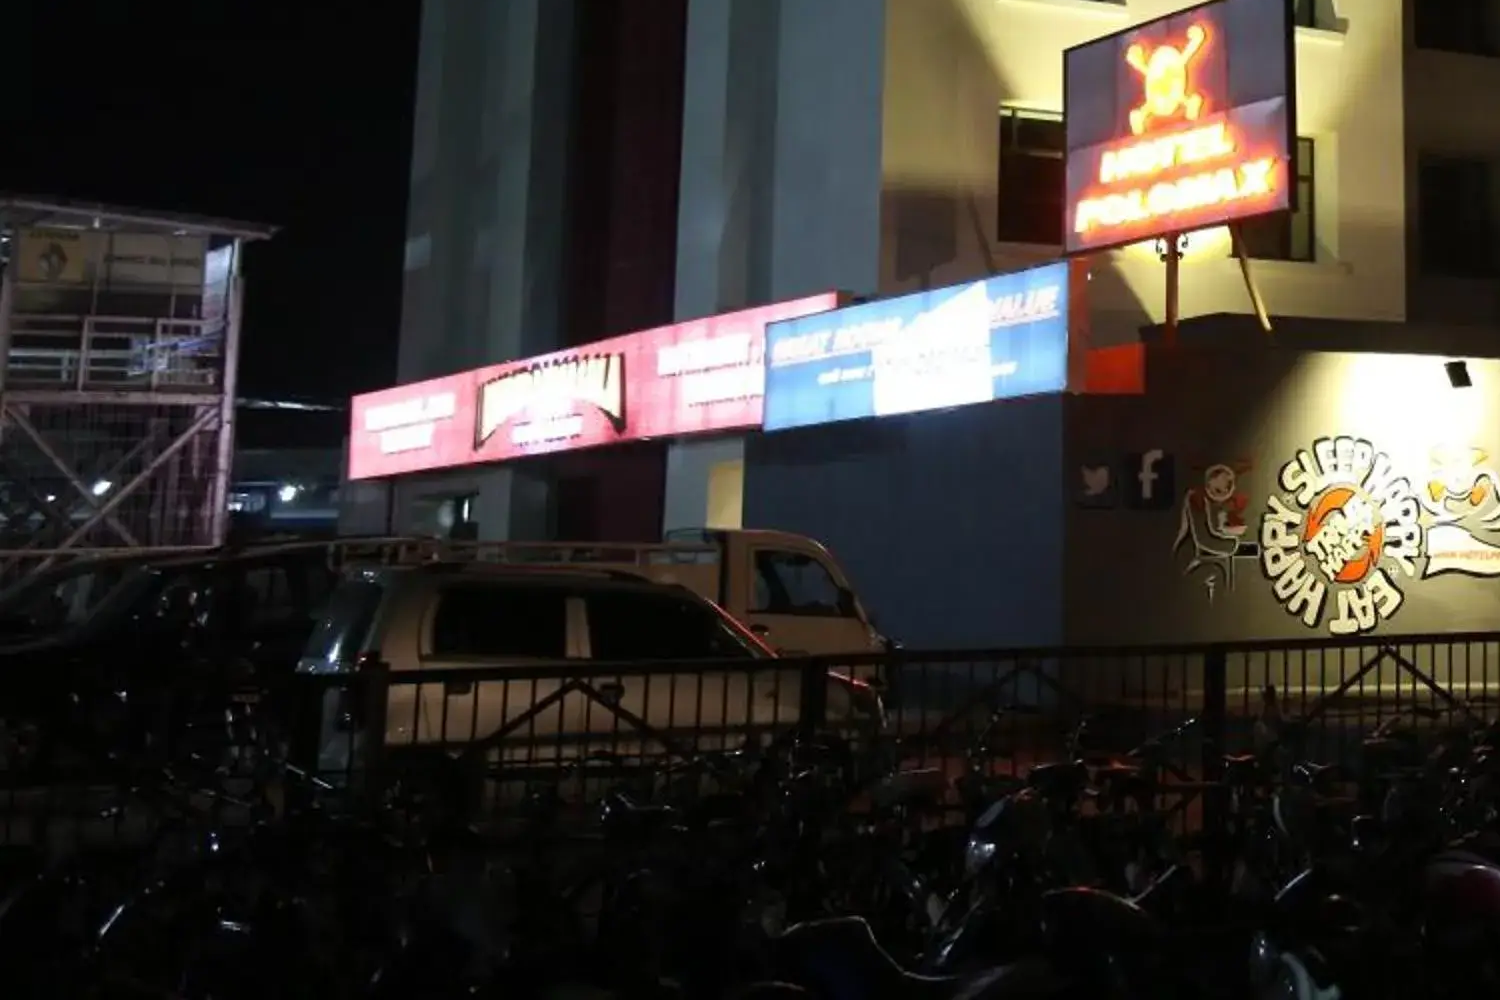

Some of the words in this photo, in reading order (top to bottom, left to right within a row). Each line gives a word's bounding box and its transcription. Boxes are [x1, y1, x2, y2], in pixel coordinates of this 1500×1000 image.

[1099, 121, 1237, 184] HOTEL
[1074, 157, 1277, 233] POLOMAX
[1277, 435, 1374, 510] SLEEP
[1257, 494, 1328, 628] HAPPY
[1329, 567, 1405, 635] EAT
